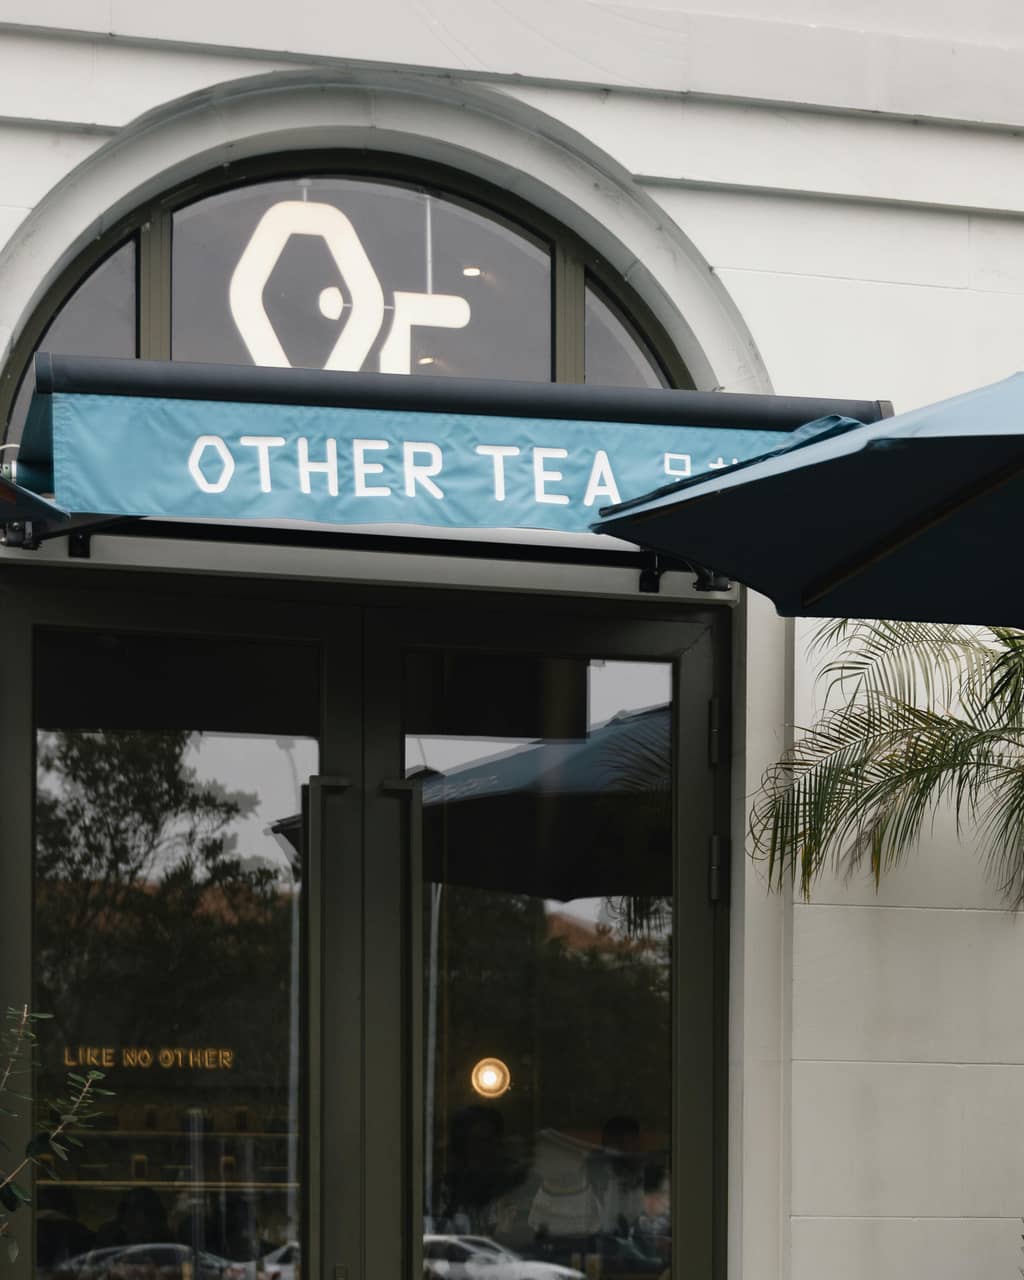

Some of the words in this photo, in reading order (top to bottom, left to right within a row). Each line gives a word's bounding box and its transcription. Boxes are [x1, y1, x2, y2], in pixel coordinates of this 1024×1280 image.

[187, 434, 445, 501] OTHER
[475, 444, 623, 508] TEA
[63, 1047, 115, 1067] LIKE
[122, 1048, 153, 1068] NO
[157, 1049, 235, 1069] OTHER
